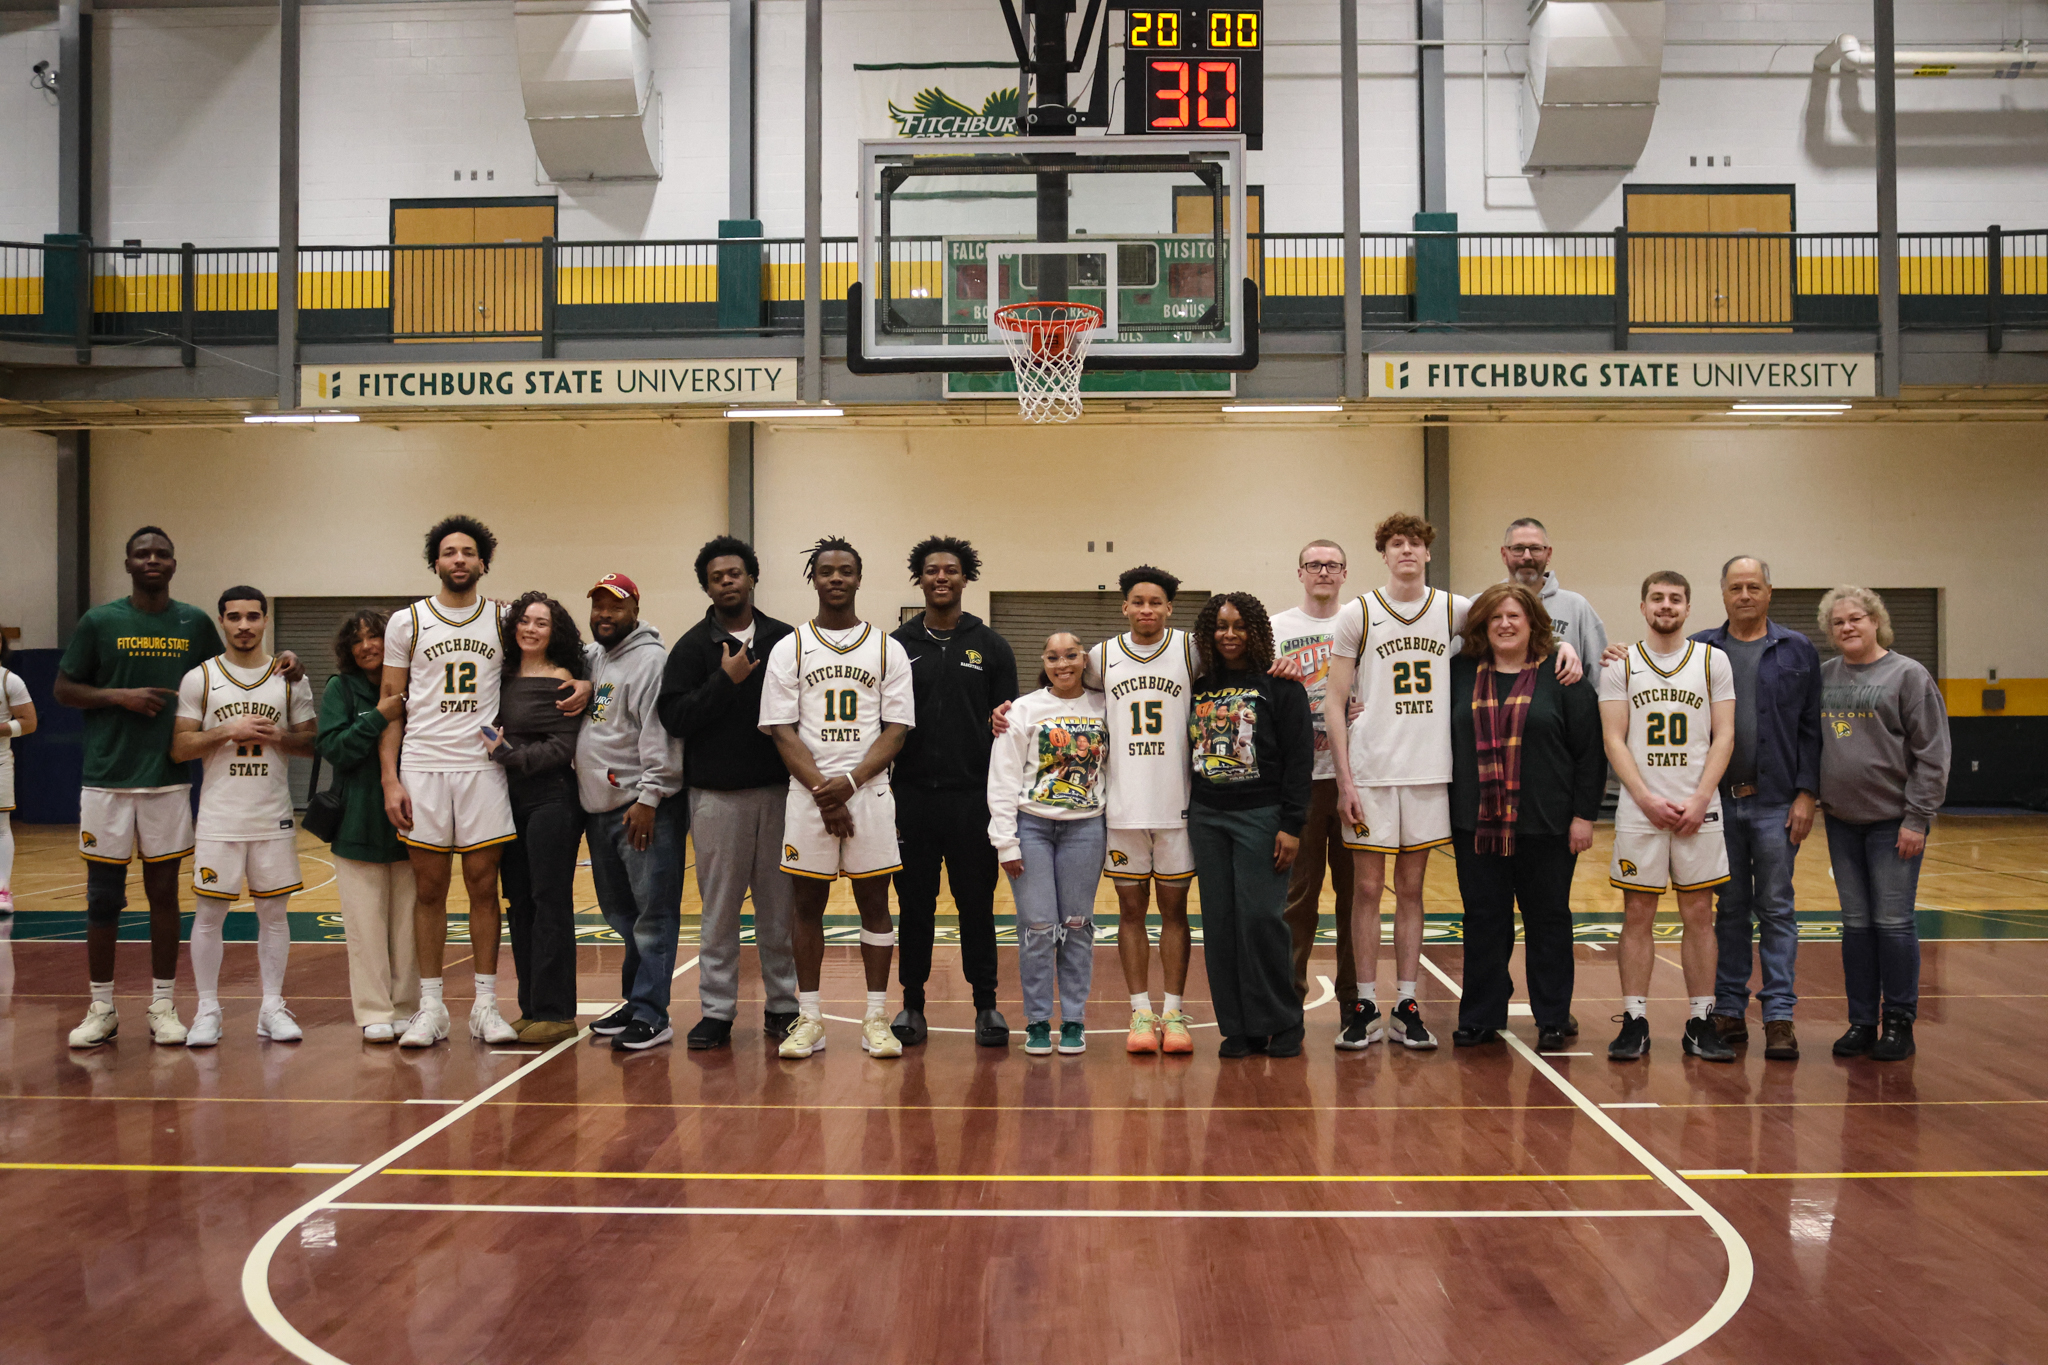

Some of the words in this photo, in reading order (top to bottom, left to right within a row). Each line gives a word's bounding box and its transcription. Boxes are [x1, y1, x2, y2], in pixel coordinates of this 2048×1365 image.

[1151, 61, 1236, 128] 30
[901, 113, 1017, 134] FITCHBUR
[1163, 303, 1206, 319] BONUS
[358, 371, 514, 397] FITCHBURG
[525, 369, 603, 396] STATE
[616, 367, 783, 394] UNIVERSITY
[1428, 362, 1588, 388] FITCHBURG
[1599, 362, 1679, 388] STATE
[1693, 362, 1859, 388] UNIVERSITY
[1551, 619, 1569, 635] ATE
[117, 636, 167, 650] FITCHBURG
[167, 637, 190, 651] STATE
[423, 638, 496, 662] FITCHBURG
[1284, 636, 1320, 653] JOHN
[1376, 636, 1447, 660] FITCHBURG
[444, 661, 478, 695] 12
[804, 665, 876, 689] FITCHBURG
[1393, 660, 1433, 696] 25
[1110, 675, 1183, 701] FITCHBURG
[440, 700, 478, 713] STATE
[824, 688, 859, 723] 10
[1395, 700, 1434, 715] STATE
[1631, 688, 1704, 710] FITCHBURG
[214, 701, 282, 723] FITCHBURG
[1130, 700, 1164, 736] 15
[1821, 711, 1874, 719] ALCONS
[821, 728, 861, 742] STATE
[1646, 711, 1688, 747] 20
[1128, 741, 1165, 756] STATE
[1216, 743, 1227, 756] 15
[229, 763, 269, 777] STATE
[1647, 752, 1688, 767] STATE
[1068, 772, 1081, 785] 15
